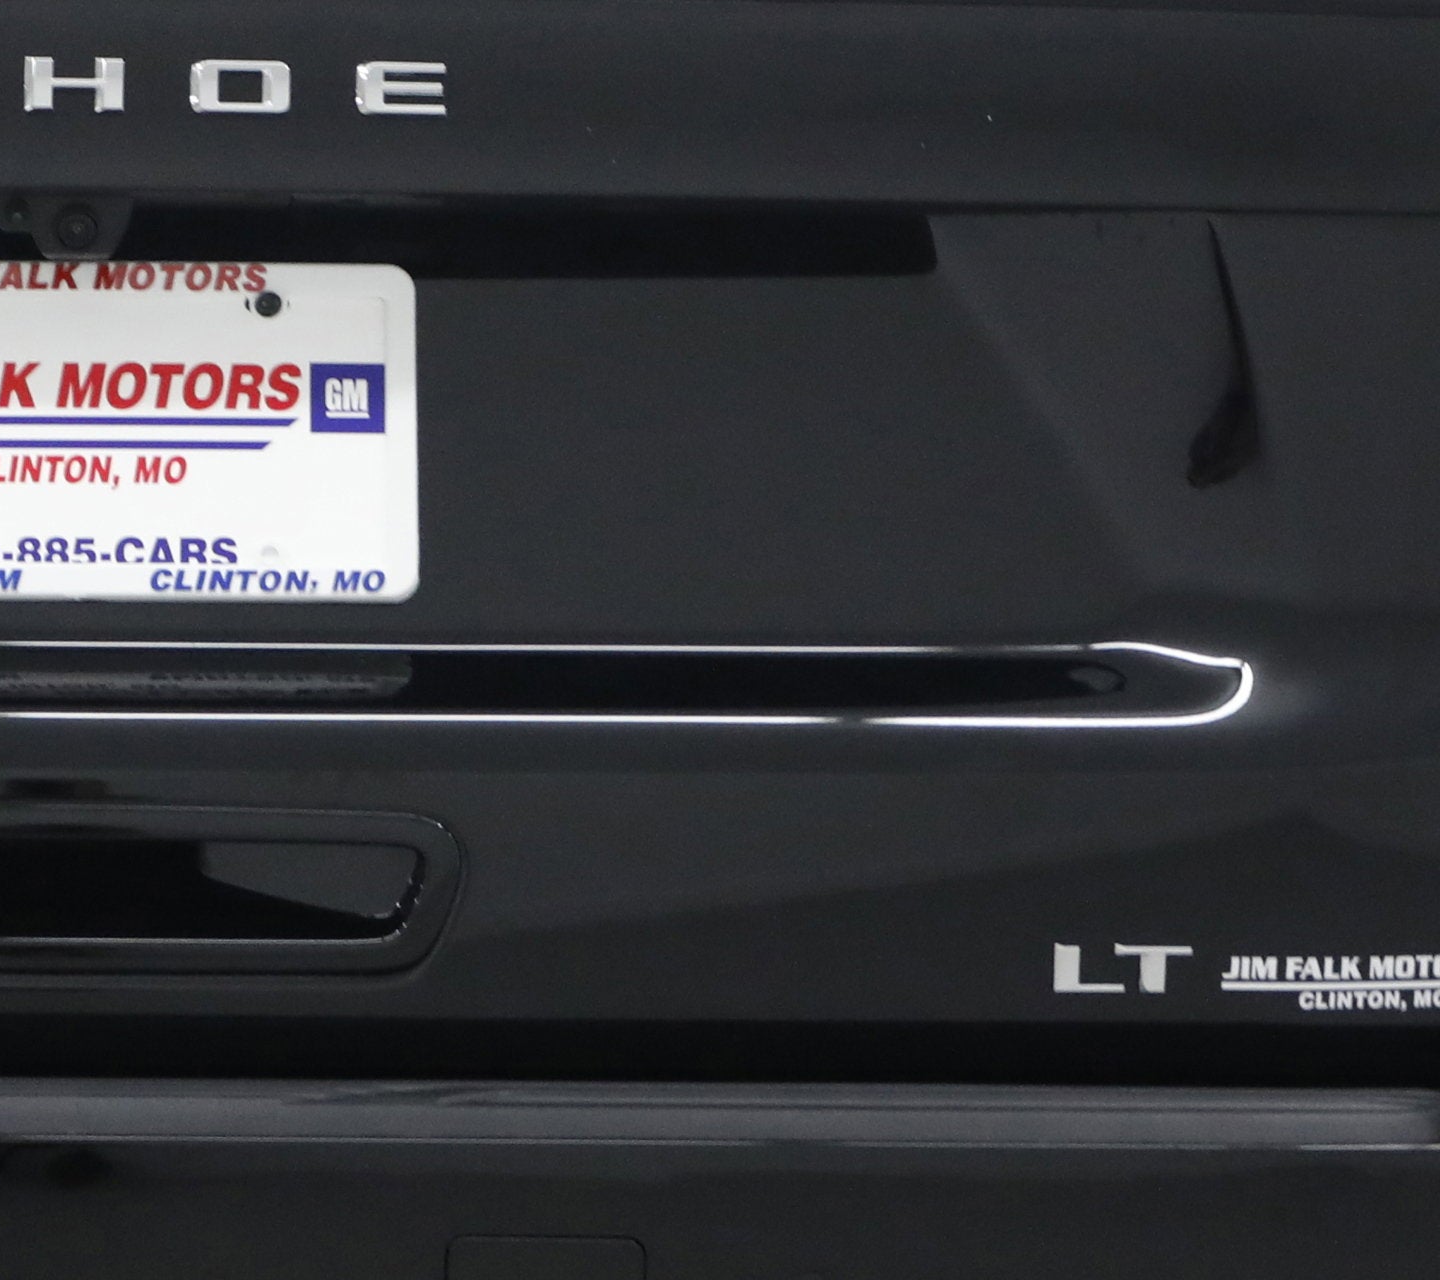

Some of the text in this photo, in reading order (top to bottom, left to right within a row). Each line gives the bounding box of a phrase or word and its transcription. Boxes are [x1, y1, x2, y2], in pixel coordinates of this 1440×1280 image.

[93, 262, 269, 293] MOTORS
[56, 361, 302, 412] MOTORS
[324, 378, 370, 415] GM
[134, 455, 188, 485] MO
[149, 568, 386, 593] CLINTON, MO
[1053, 942, 1194, 993] LT
[1221, 955, 1278, 979] JIM
[1285, 955, 1361, 980] FALK
[1298, 989, 1408, 1011] CLINTON,
